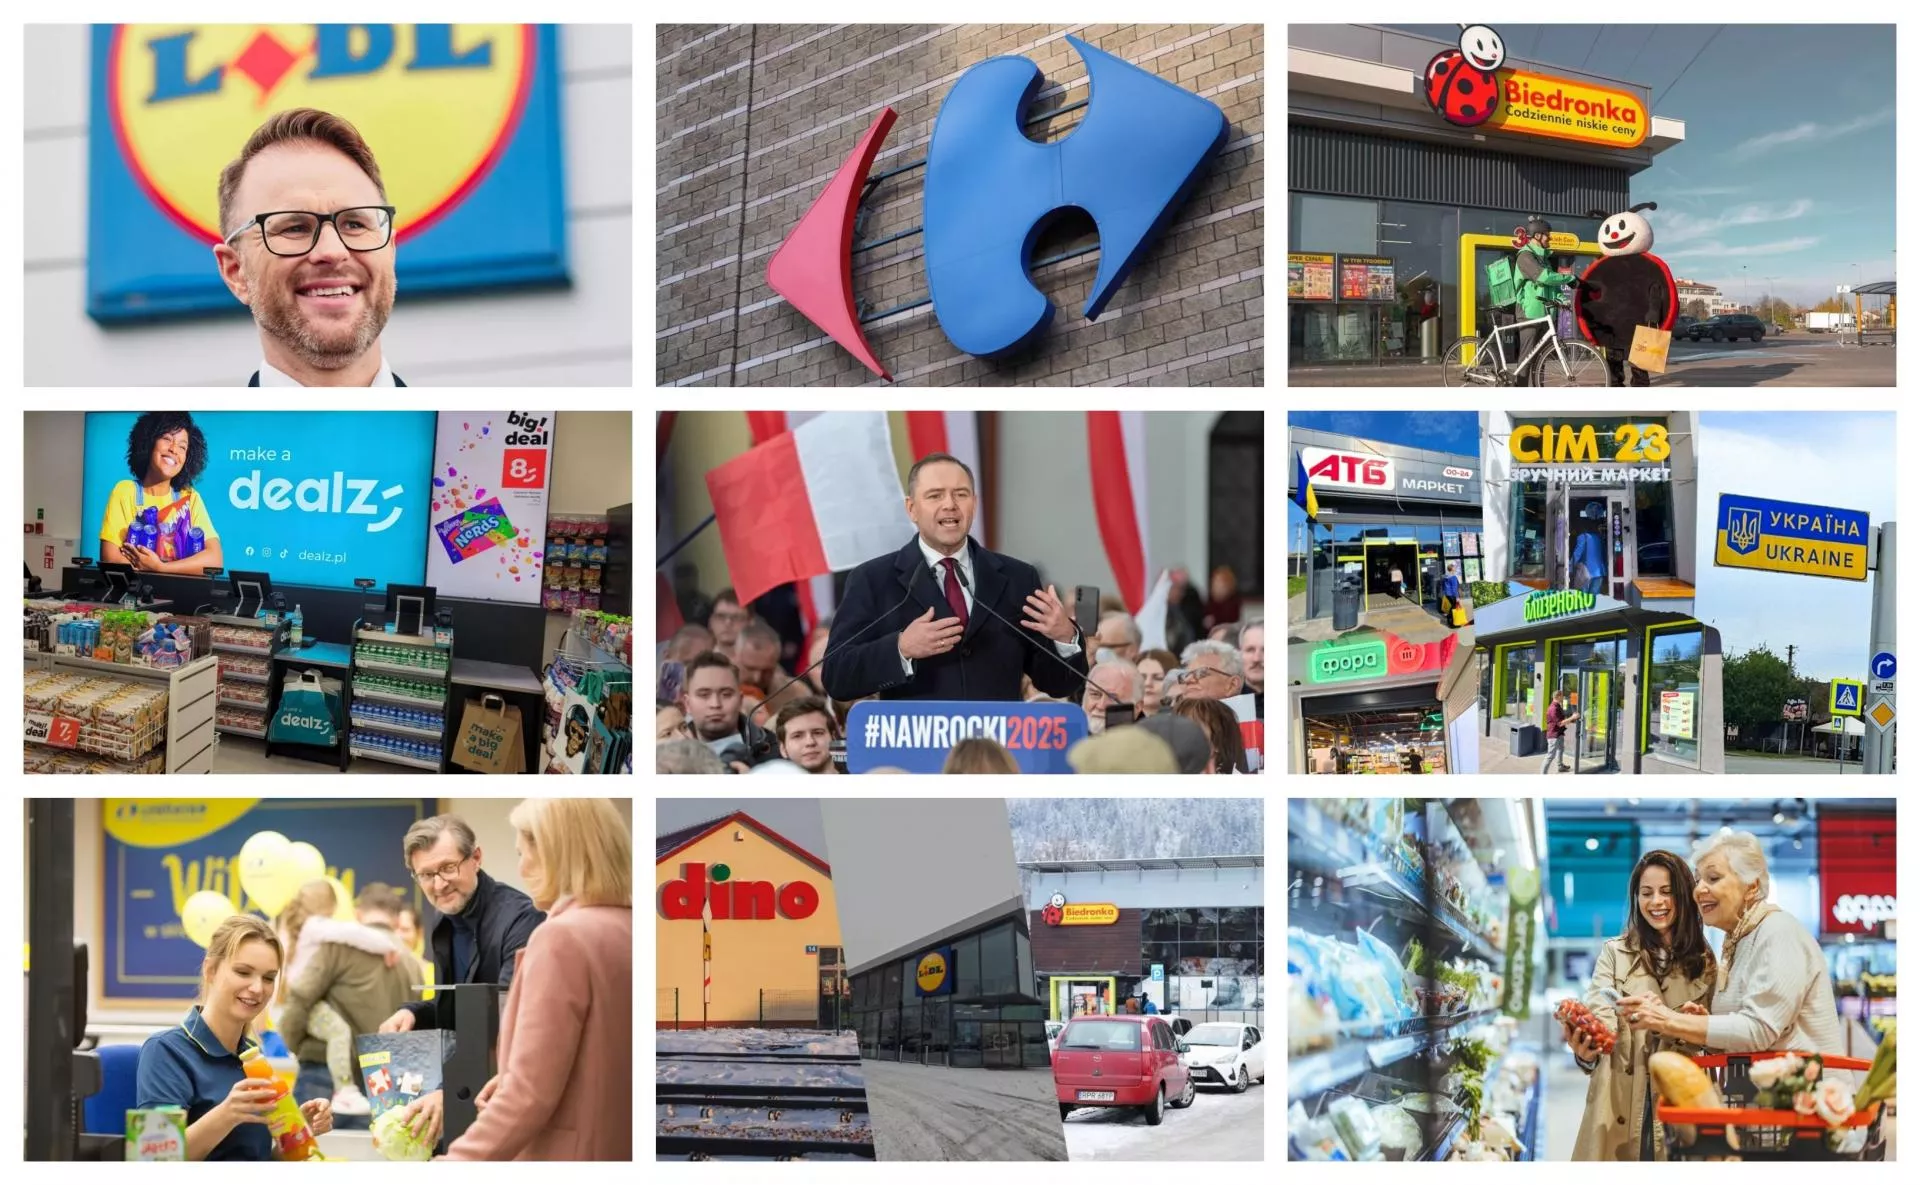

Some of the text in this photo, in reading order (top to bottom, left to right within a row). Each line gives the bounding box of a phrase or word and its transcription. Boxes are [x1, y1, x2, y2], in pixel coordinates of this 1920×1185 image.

[1505, 79, 1637, 124] Biedronka
[1505, 104, 1637, 138] Codziennie niskie ceny
[507, 411, 547, 433] big!
[504, 431, 548, 446] deal
[1615, 423, 1671, 463] 23
[230, 446, 291, 461] make a
[1446, 468, 1470, 477] 00-24
[1510, 465, 1671, 482] ЗРУЧНИЙ МАРКЕТ
[229, 470, 380, 515] dealz
[1402, 478, 1465, 495] МАРКЕТ
[1770, 511, 1860, 537] УКРАЇНА
[298, 550, 346, 565] dealz.pl
[1766, 543, 1854, 568] UKRAINE
[1322, 652, 1377, 675] фора
[281, 713, 323, 730] dealz
[25, 728, 48, 738] deal
[471, 722, 503, 742] make
[468, 745, 494, 760] deal
[479, 738, 498, 751] big
[662, 863, 820, 920] dino
[1066, 908, 1114, 916] Biedronka
